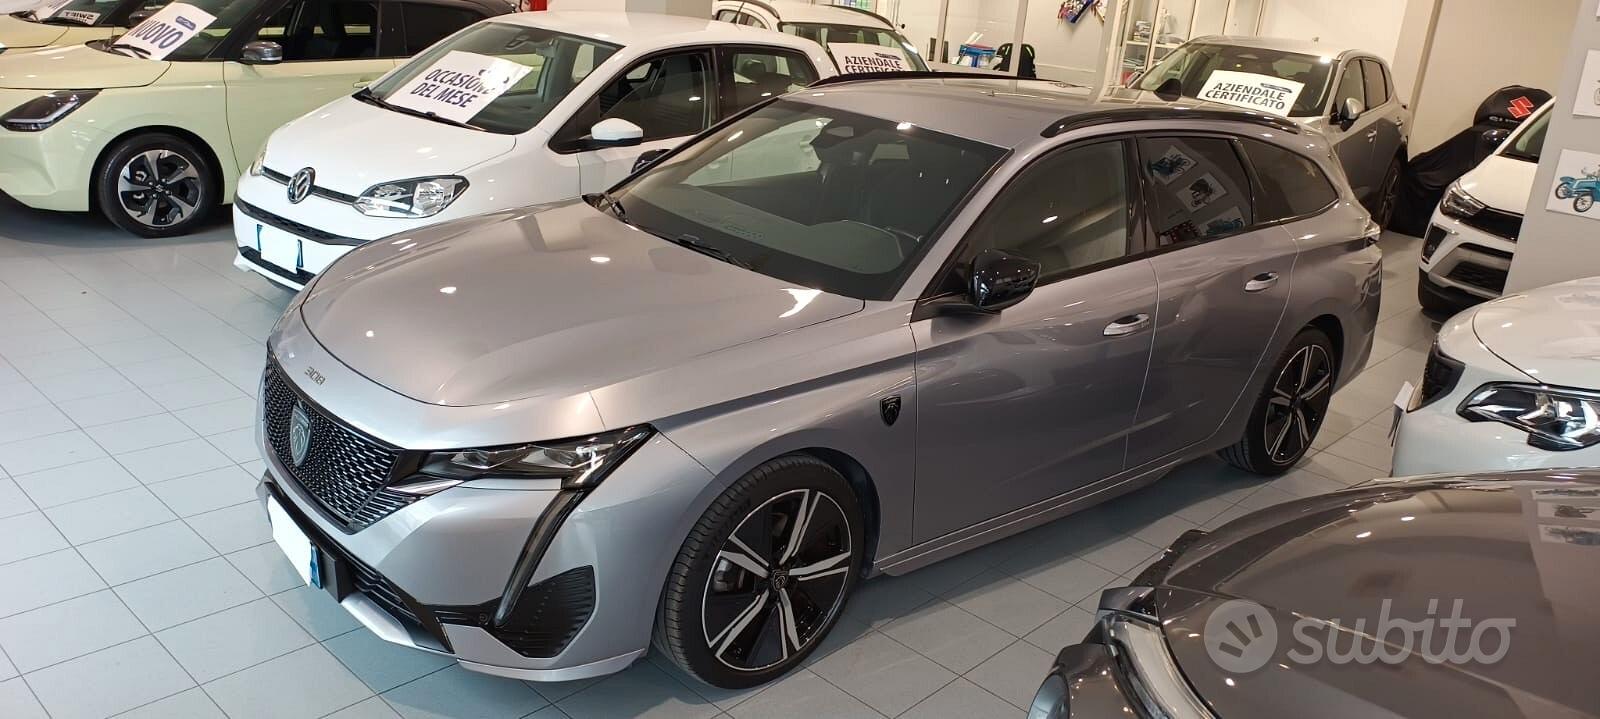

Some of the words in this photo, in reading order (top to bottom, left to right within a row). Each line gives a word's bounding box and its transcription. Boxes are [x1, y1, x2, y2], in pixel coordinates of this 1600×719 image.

[127, 19, 183, 49] NUOVO
[844, 55, 902, 69] AZIENDALE
[410, 82, 436, 99] DEL
[433, 86, 478, 108] MESE
[1205, 89, 1285, 110] CERTIFICATO
[1213, 82, 1285, 100] AZIENDALE
[304, 366, 326, 386] 308
